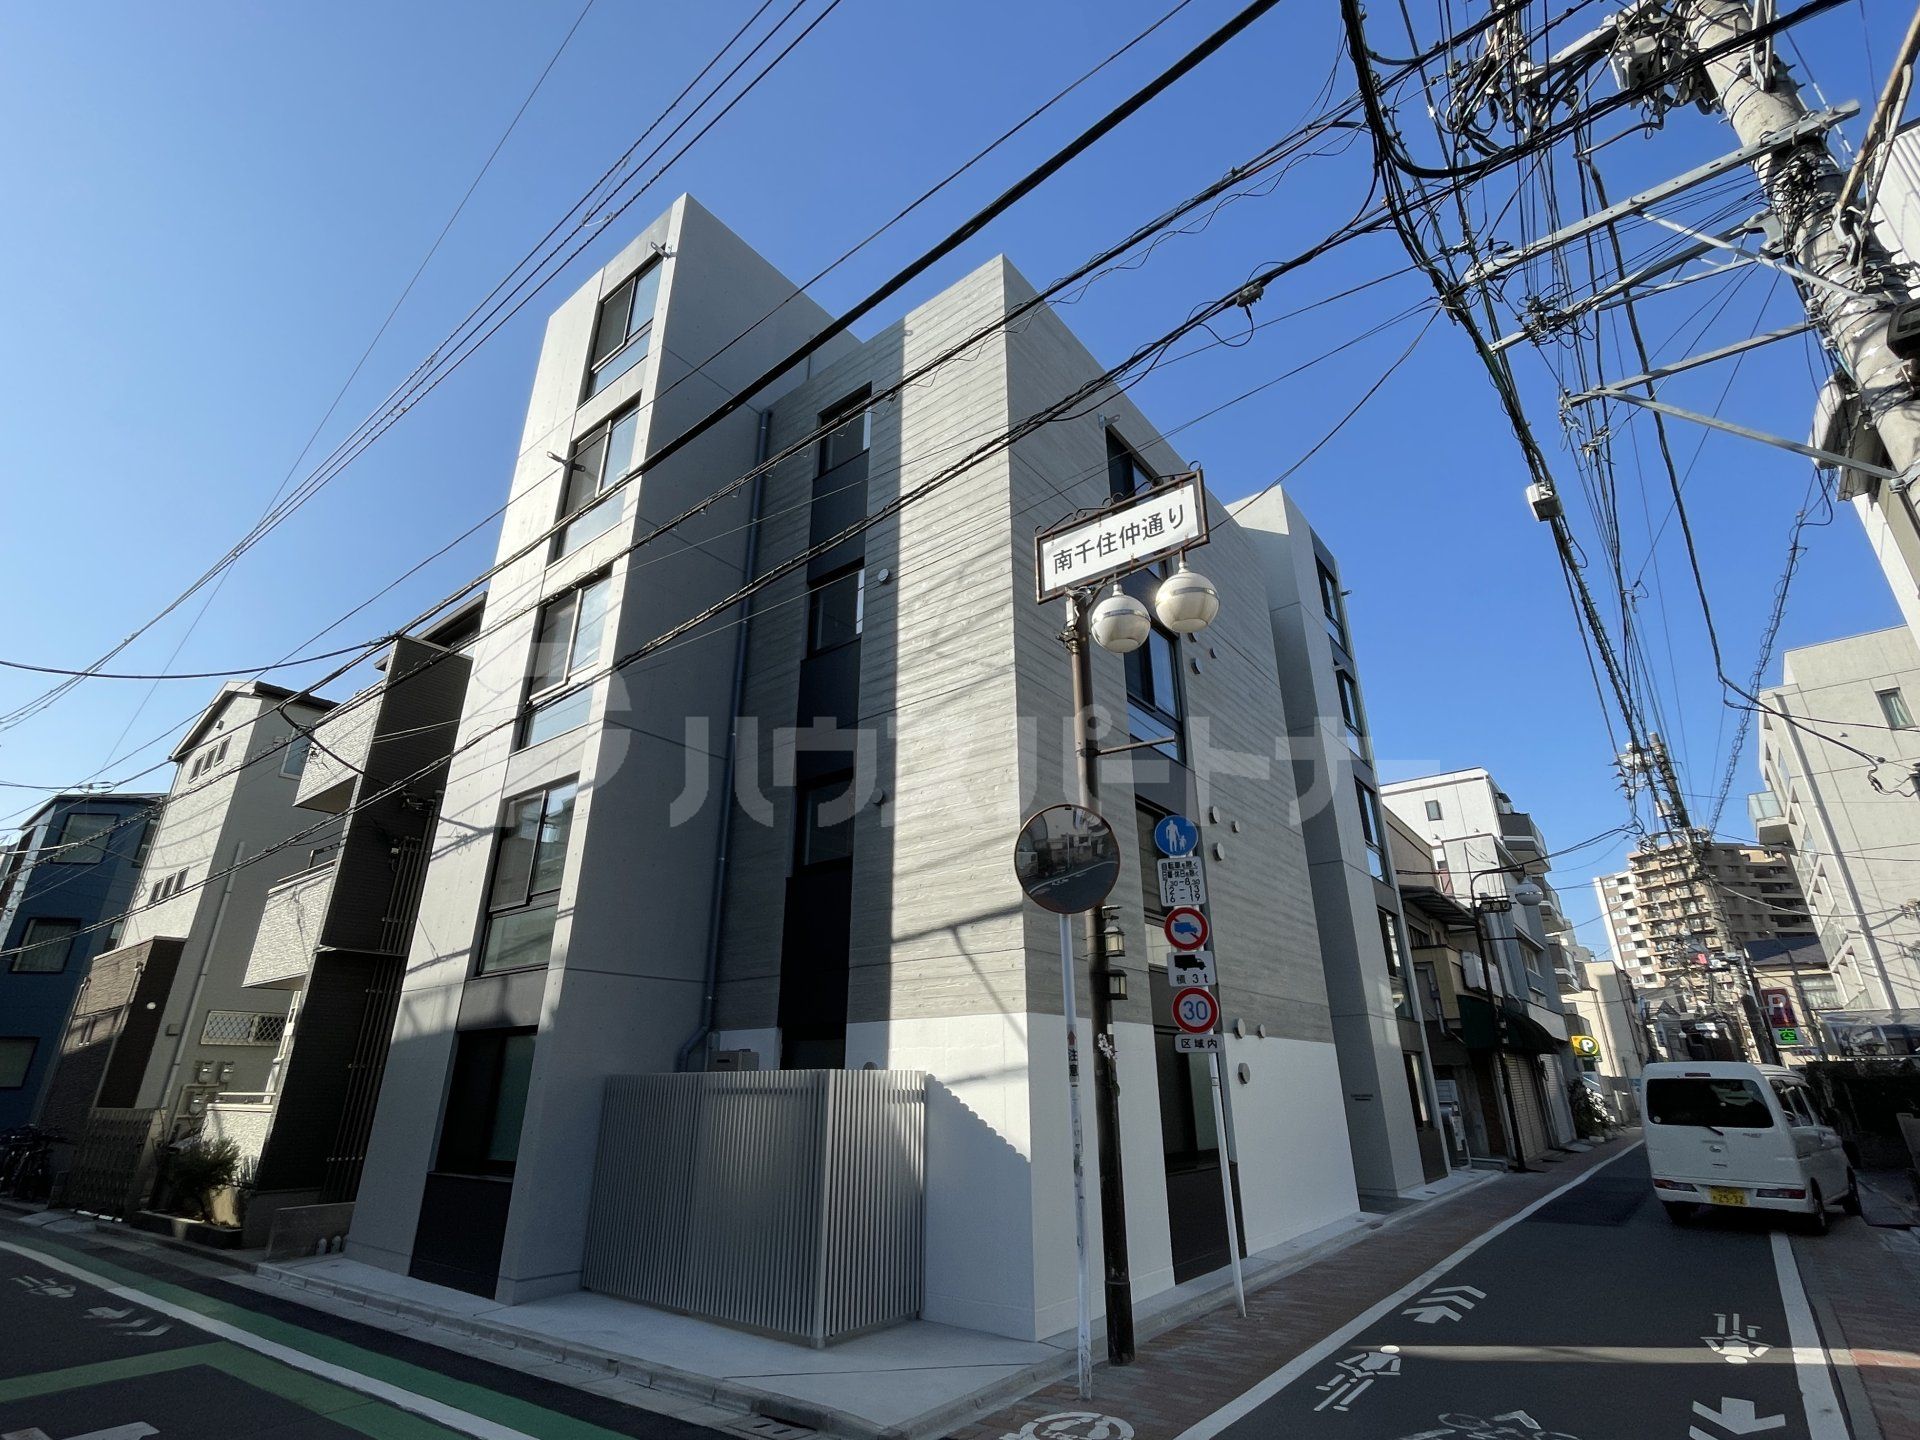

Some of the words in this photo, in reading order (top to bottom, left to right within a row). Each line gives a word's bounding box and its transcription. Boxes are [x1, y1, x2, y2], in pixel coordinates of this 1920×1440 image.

[1053, 503, 1184, 574] 南千住仲通り
[1183, 1000, 1208, 1021] 30
[1181, 1038, 1218, 1049] 区域内
[1581, 1039, 1594, 1052] P
